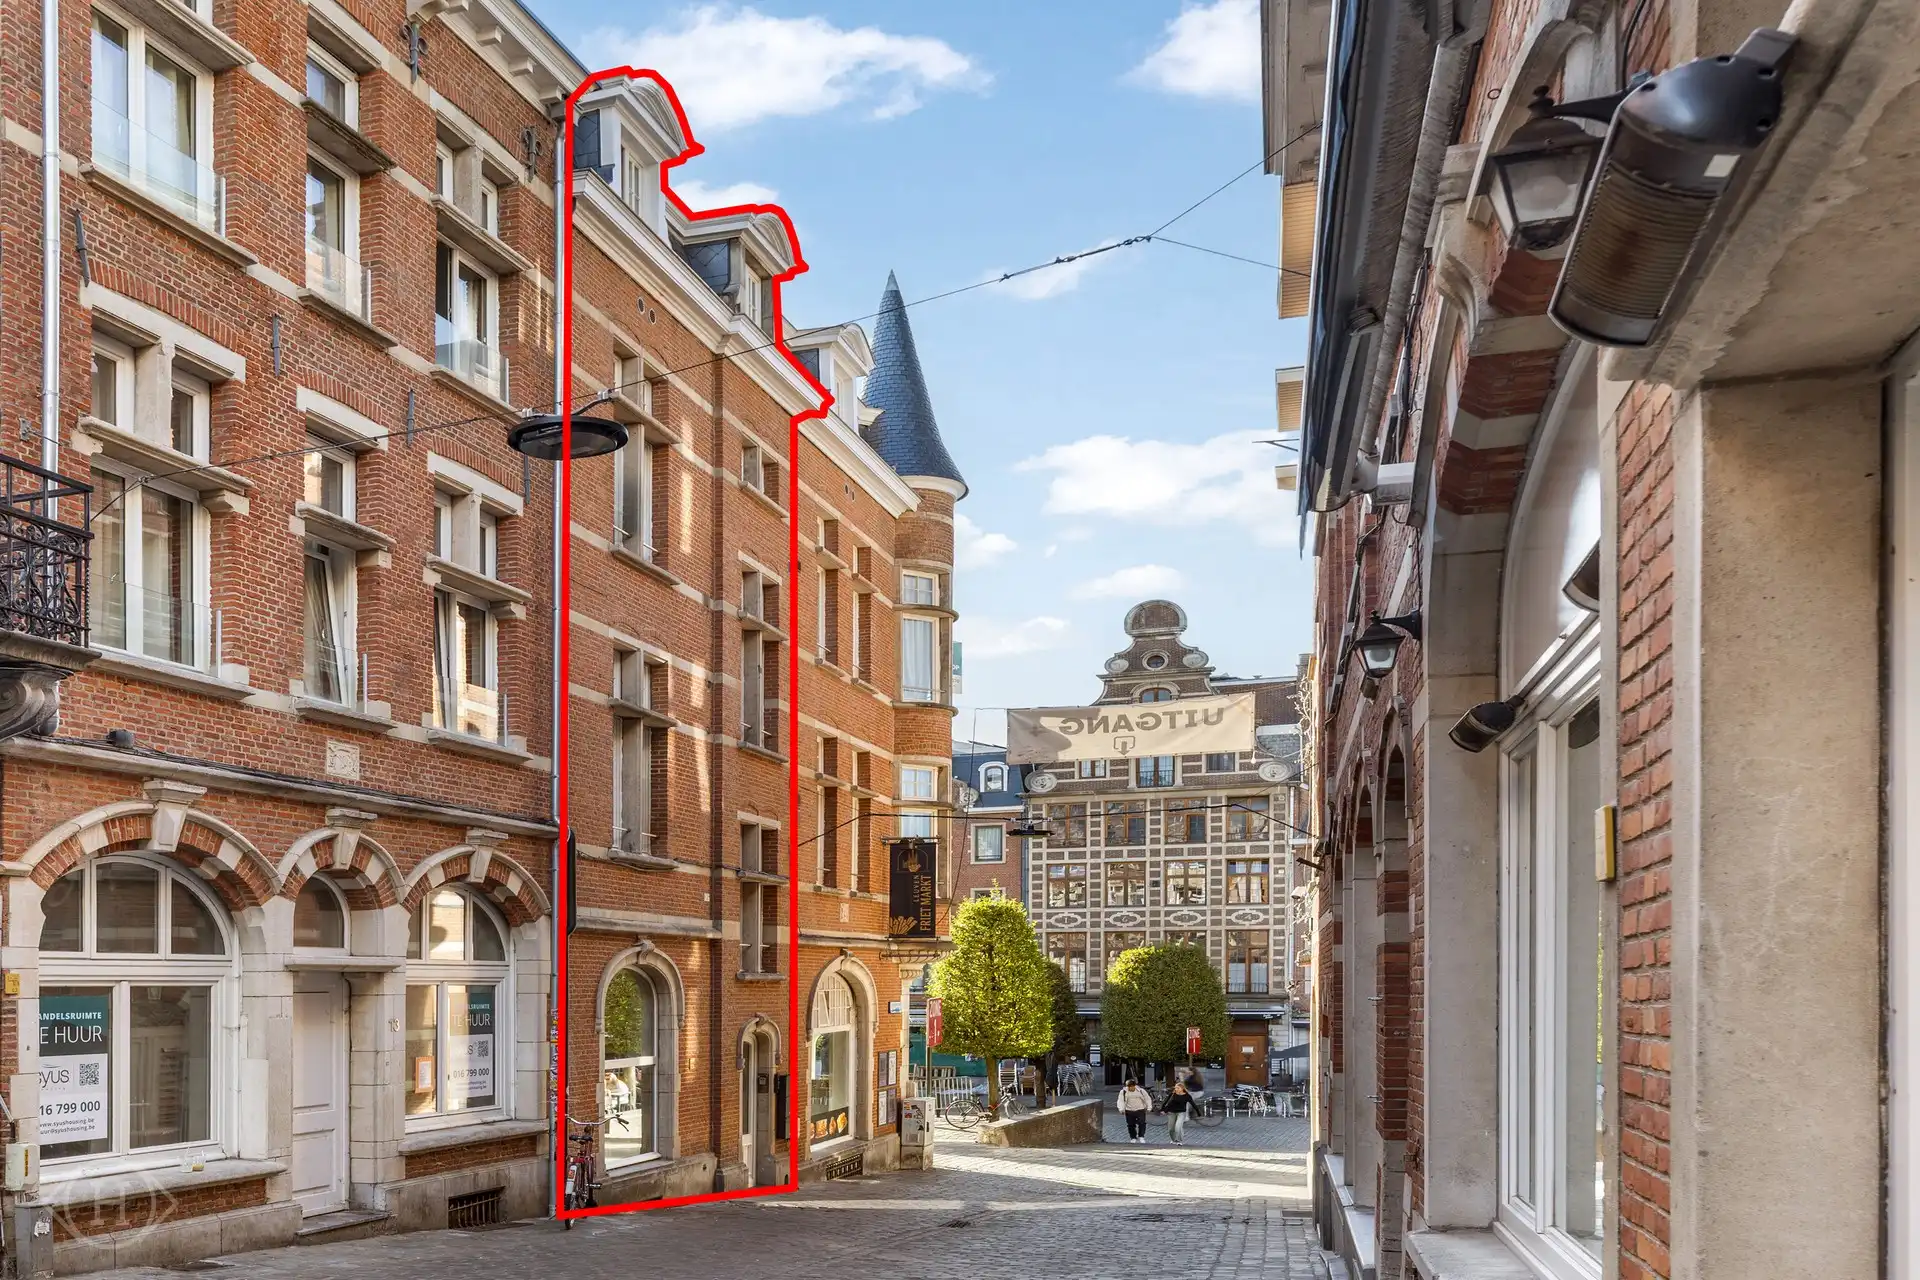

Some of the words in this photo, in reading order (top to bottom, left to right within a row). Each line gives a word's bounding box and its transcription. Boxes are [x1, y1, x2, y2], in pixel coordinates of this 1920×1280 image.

[920, 875, 931, 905] MARKT
[920, 908, 931, 931] FRIET
[388, 1018, 400, 1032] 13
[464, 1013, 491, 1027] HUUR
[54, 1025, 103, 1044] HUUR
[453, 1070, 465, 1078] 016
[466, 1069, 477, 1077] 799
[478, 1067, 490, 1076] 000
[39, 1104, 53, 1116] 16
[56, 1102, 77, 1115] 799
[80, 1100, 101, 1112] 000
